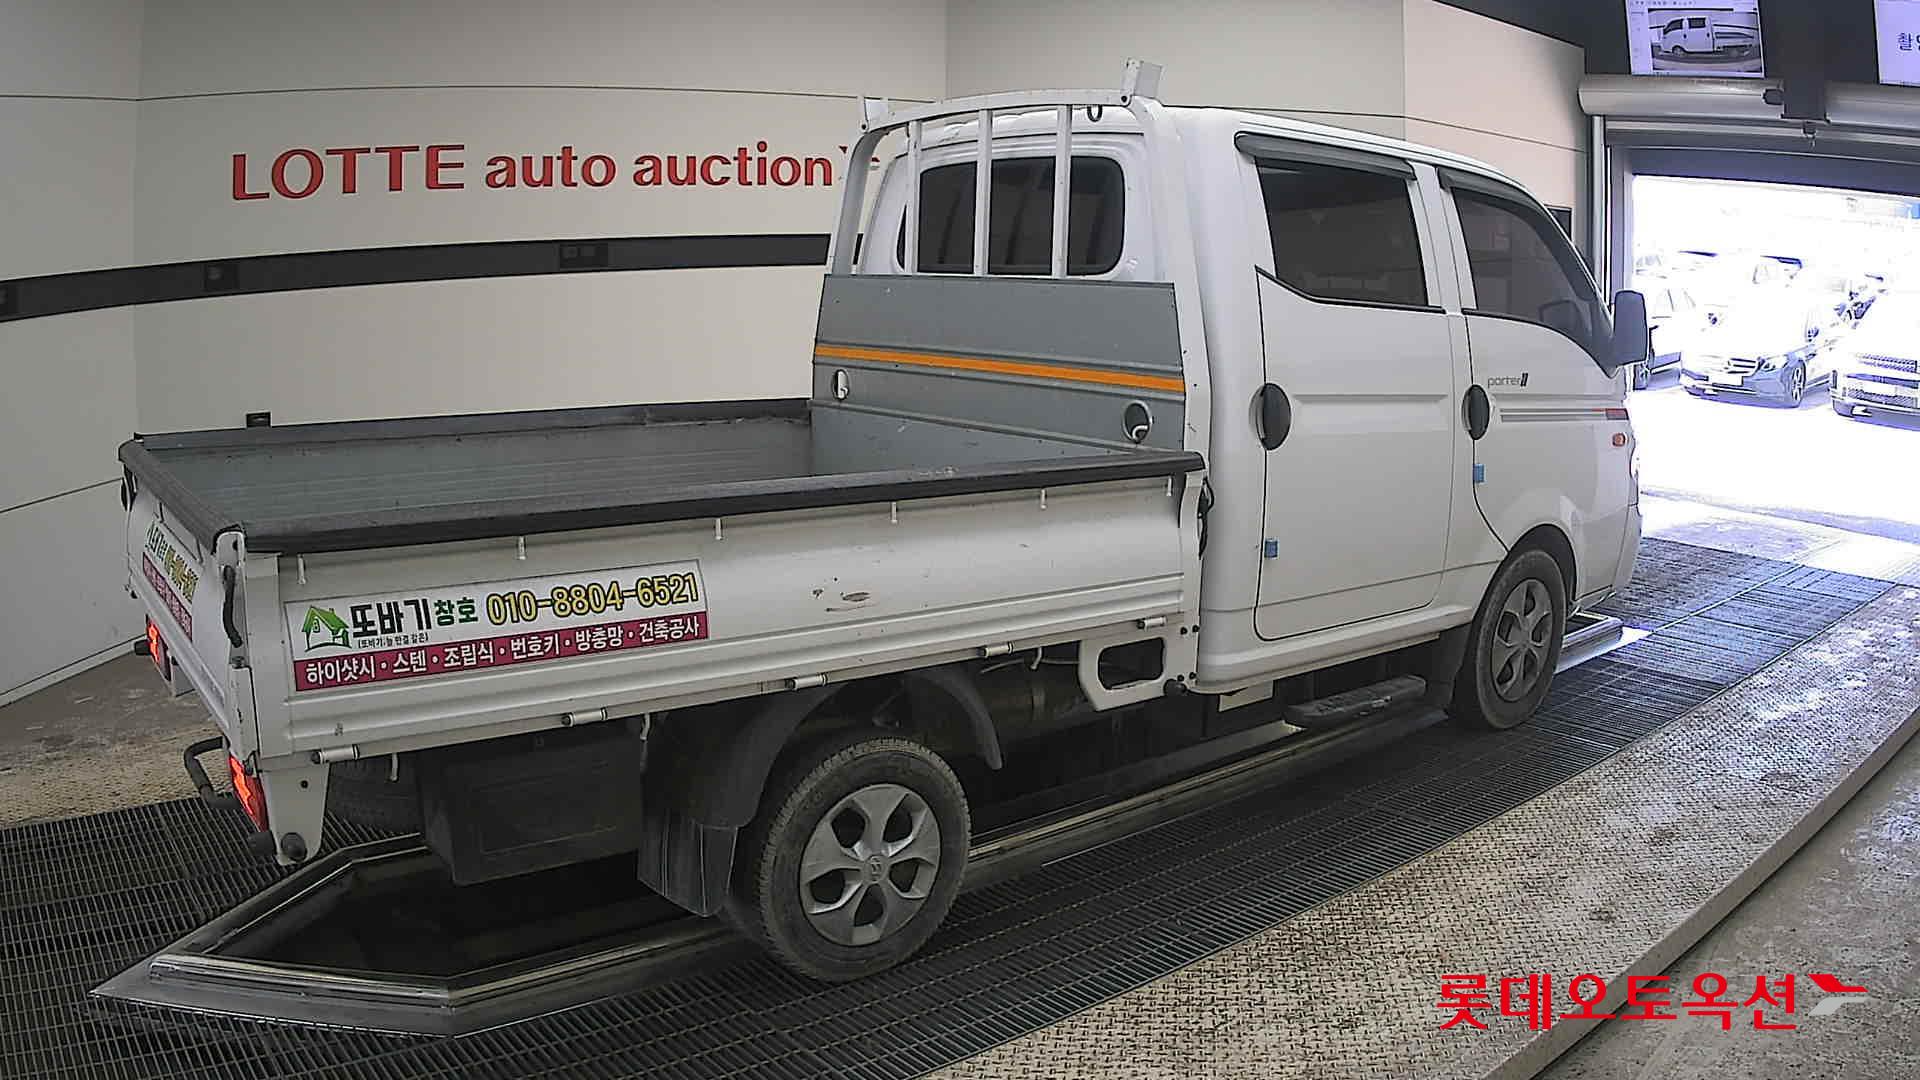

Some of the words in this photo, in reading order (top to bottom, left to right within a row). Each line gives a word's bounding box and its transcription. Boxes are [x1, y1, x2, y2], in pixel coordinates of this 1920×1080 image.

[232, 144, 465, 200] LOTTE
[485, 146, 616, 188] auto
[632, 141, 833, 188] auction
[350, 598, 432, 638] 또바기
[434, 596, 478, 627] 창호
[486, 572, 699, 626] 010-8804-6521
[306, 655, 376, 685] 하이샷시
[393, 649, 427, 673] 스텐
[443, 641, 495, 667] 조립식
[510, 632, 560, 660] 번호키
[575, 625, 624, 652] 방충망
[639, 615, 700, 643] 건축공사
